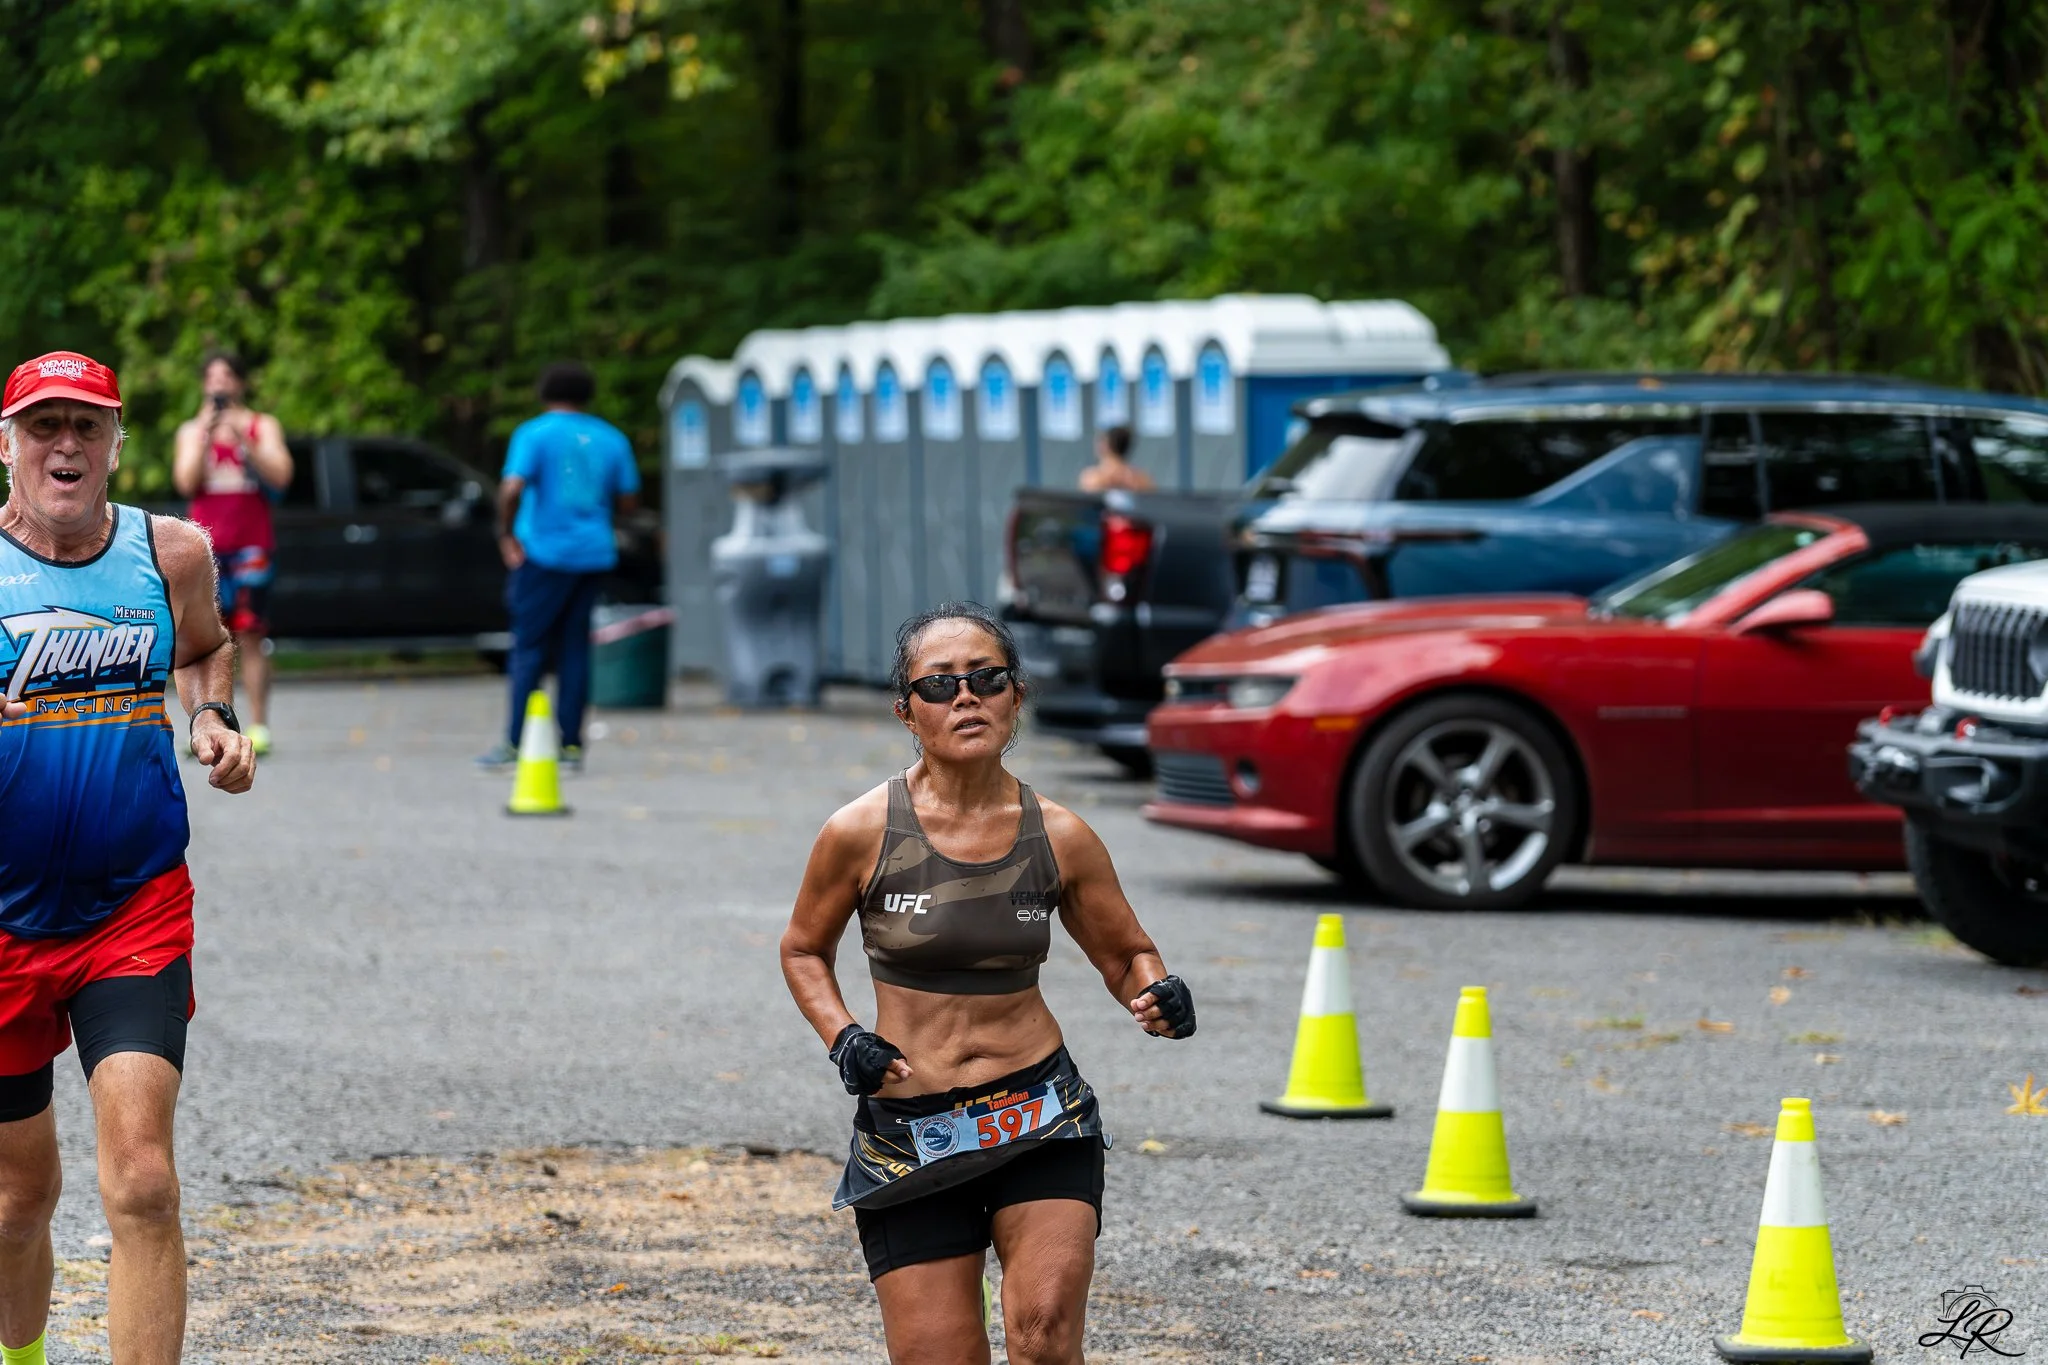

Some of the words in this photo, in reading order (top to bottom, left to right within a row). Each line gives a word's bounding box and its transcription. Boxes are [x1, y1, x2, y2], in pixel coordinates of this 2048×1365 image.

[38, 360, 87, 370] MEMPHIS
[0, 606, 158, 702] THUNDER
[36, 698, 131, 713] RACING
[884, 894, 931, 914] UFC
[1010, 891, 1048, 906] VENU
[987, 1091, 1029, 1111] Tanielian
[977, 1099, 1043, 1148] 597
